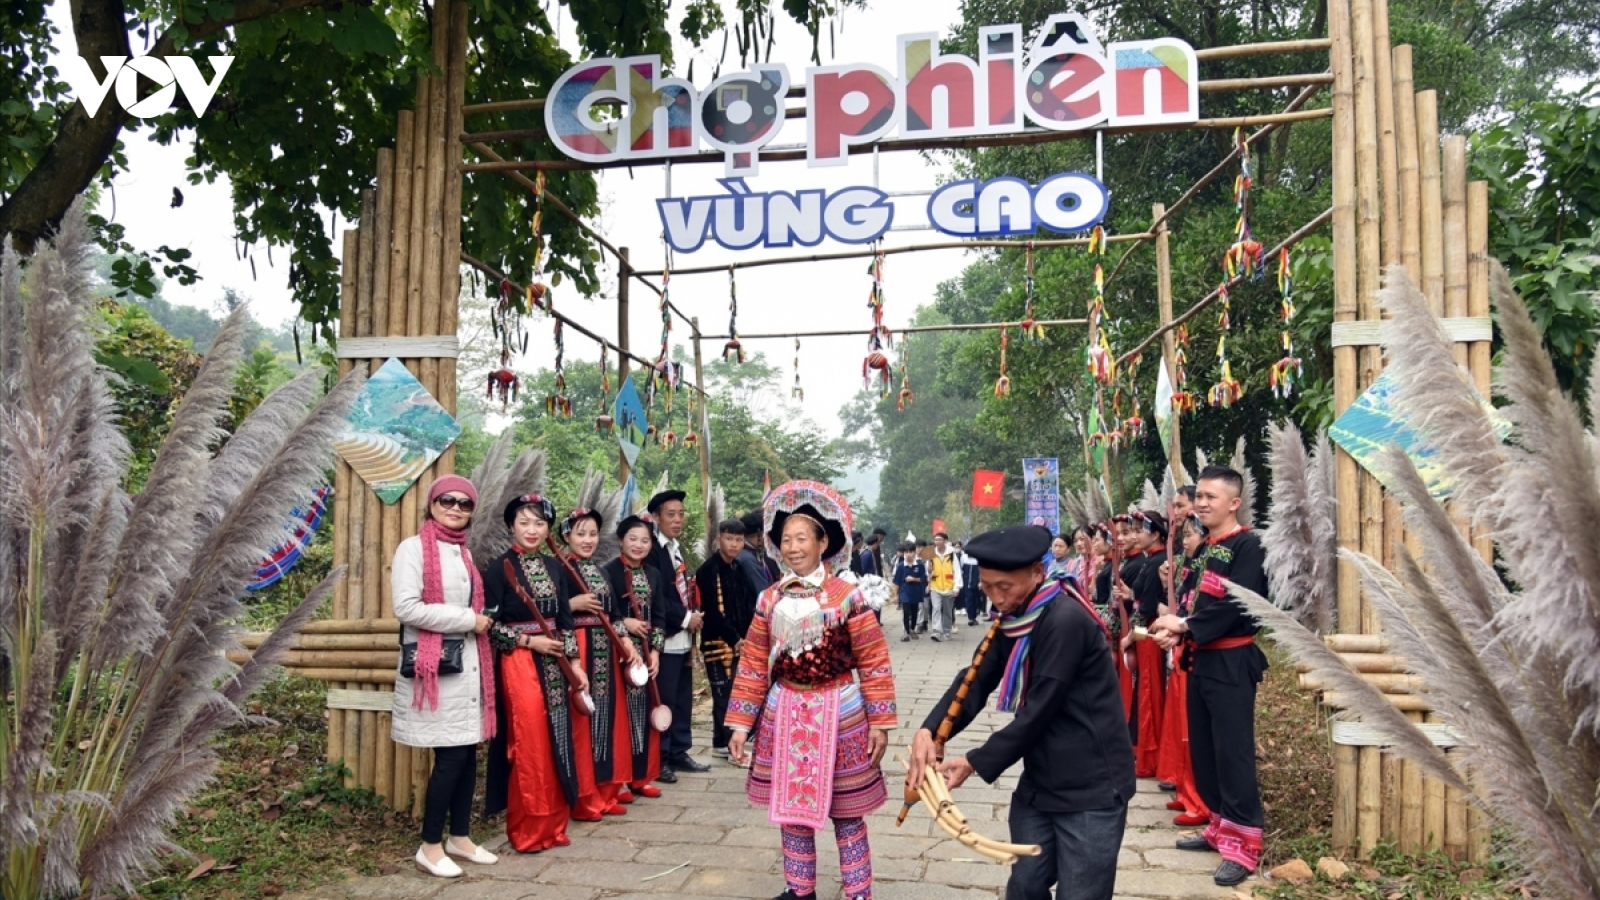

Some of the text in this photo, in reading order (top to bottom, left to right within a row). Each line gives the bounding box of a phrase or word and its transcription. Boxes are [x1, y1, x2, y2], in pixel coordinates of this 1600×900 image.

[544, 13, 1199, 176] Chợ phiên
[656, 172, 1109, 253] VÙNG CAO
